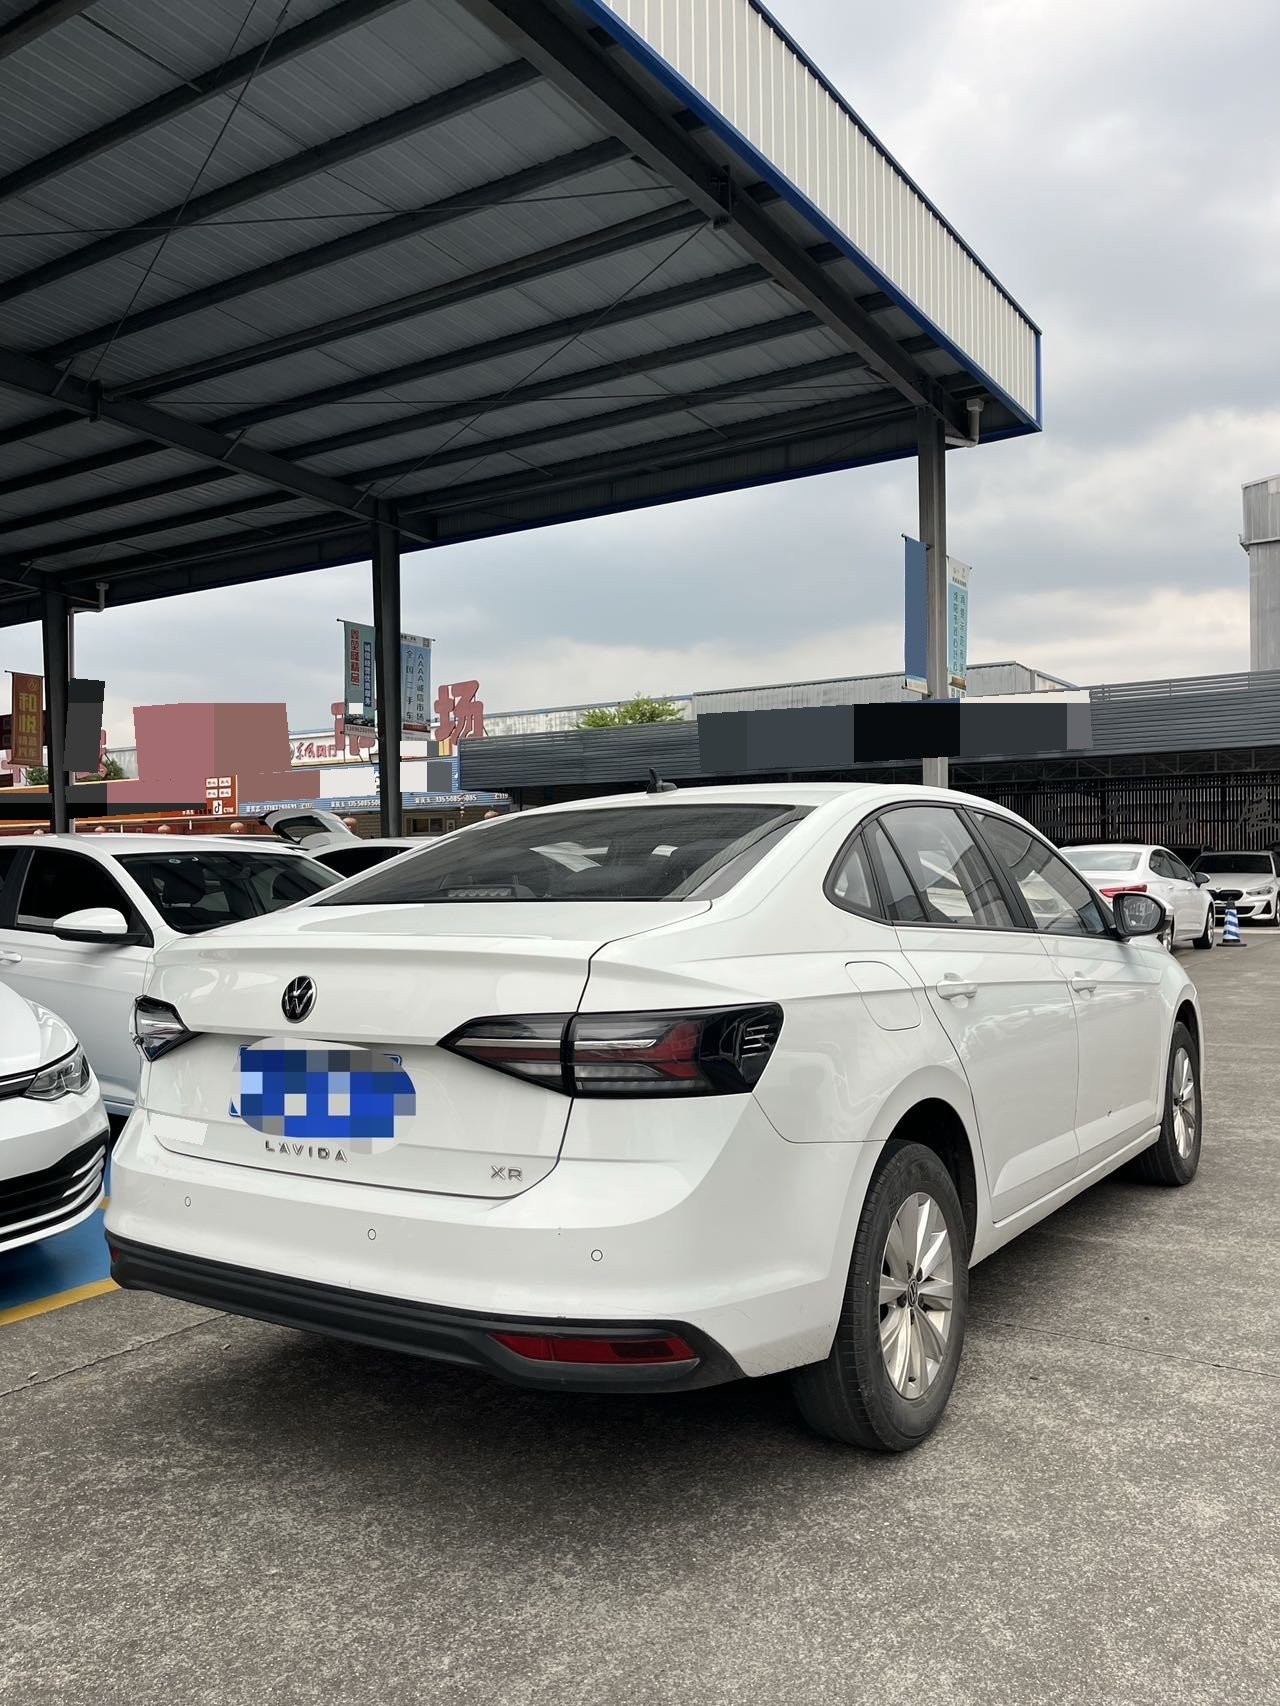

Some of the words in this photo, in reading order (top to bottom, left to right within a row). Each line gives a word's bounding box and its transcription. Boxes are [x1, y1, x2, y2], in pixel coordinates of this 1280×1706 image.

[406, 649, 414, 720] 全国二手车
[417, 653, 425, 720] AAAA诚信市场
[265, 1140, 348, 1163] LAVIDA
[491, 1165, 523, 1181] XR
